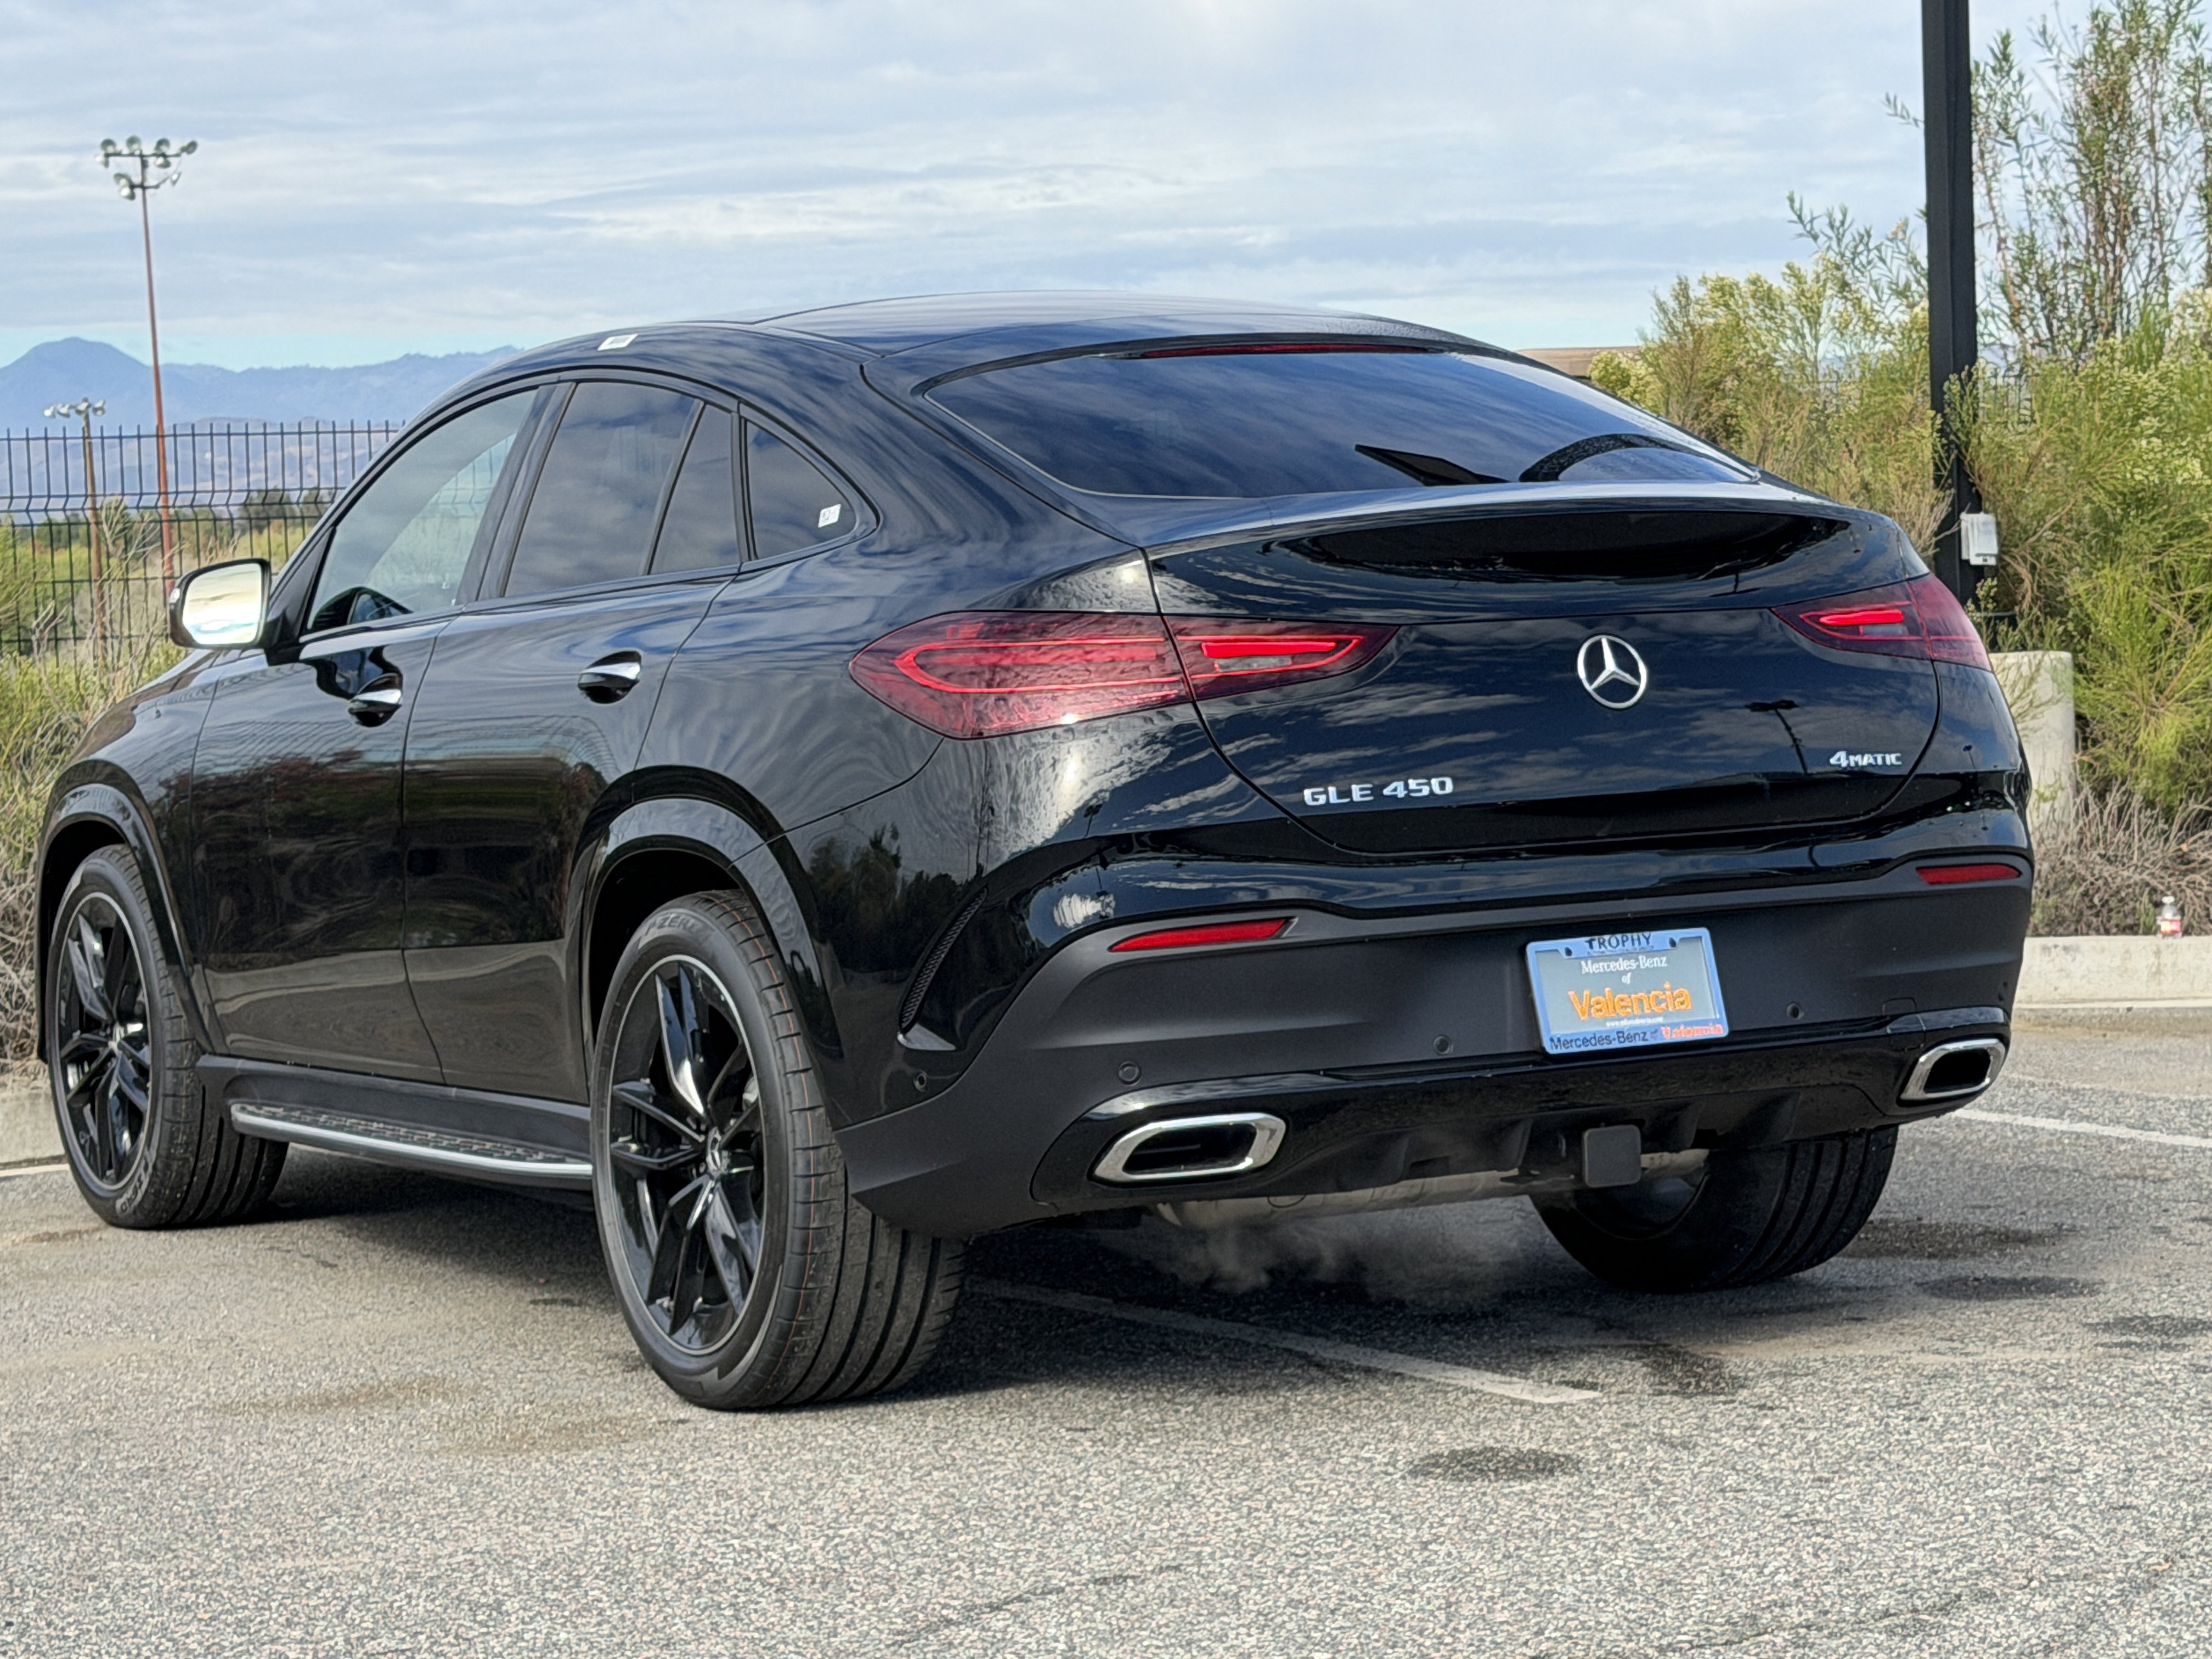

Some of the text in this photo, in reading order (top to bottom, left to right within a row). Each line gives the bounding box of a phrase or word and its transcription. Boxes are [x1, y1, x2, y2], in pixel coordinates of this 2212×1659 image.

[1830, 751, 1903, 768] 4MATIC
[1304, 777, 1453, 806] GLE 450
[1585, 933, 1651, 950] TROPHY
[1581, 955, 1668, 974] Mercedes-Benz
[1622, 972, 1632, 984] of
[1568, 981, 1692, 1021] Valencia
